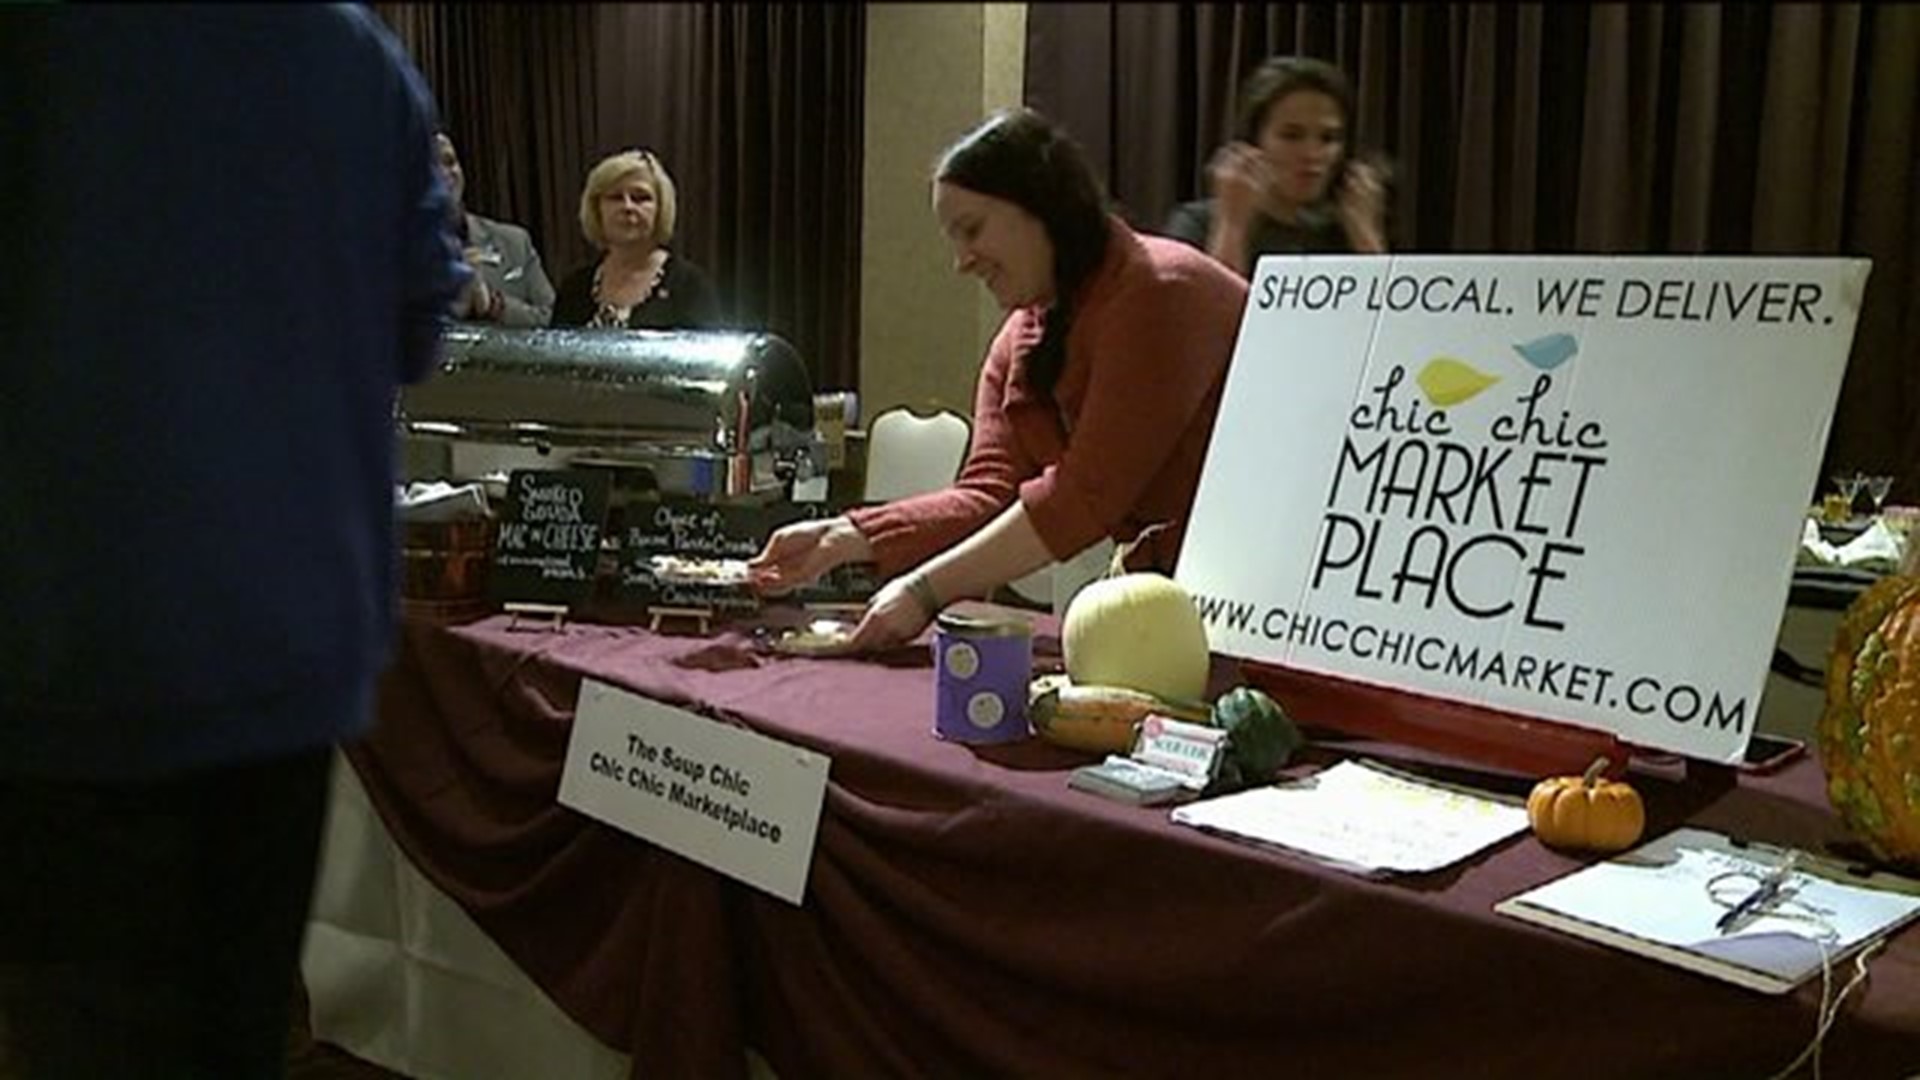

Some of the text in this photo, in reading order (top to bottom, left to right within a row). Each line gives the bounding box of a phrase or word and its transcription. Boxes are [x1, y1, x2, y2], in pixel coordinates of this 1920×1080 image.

[1257, 275, 1834, 324] SHOP LOCAL. WE DELIVER.
[1350, 366, 1608, 449] chic chic
[1326, 437, 1607, 538] MARKET
[1311, 513, 1584, 631] PLACE
[1192, 594, 1746, 734] WW.CHICCHICMARKET.COM
[590, 752, 782, 844] Chic Chic Marketplace
[627, 734, 750, 796] The Soup Chic
